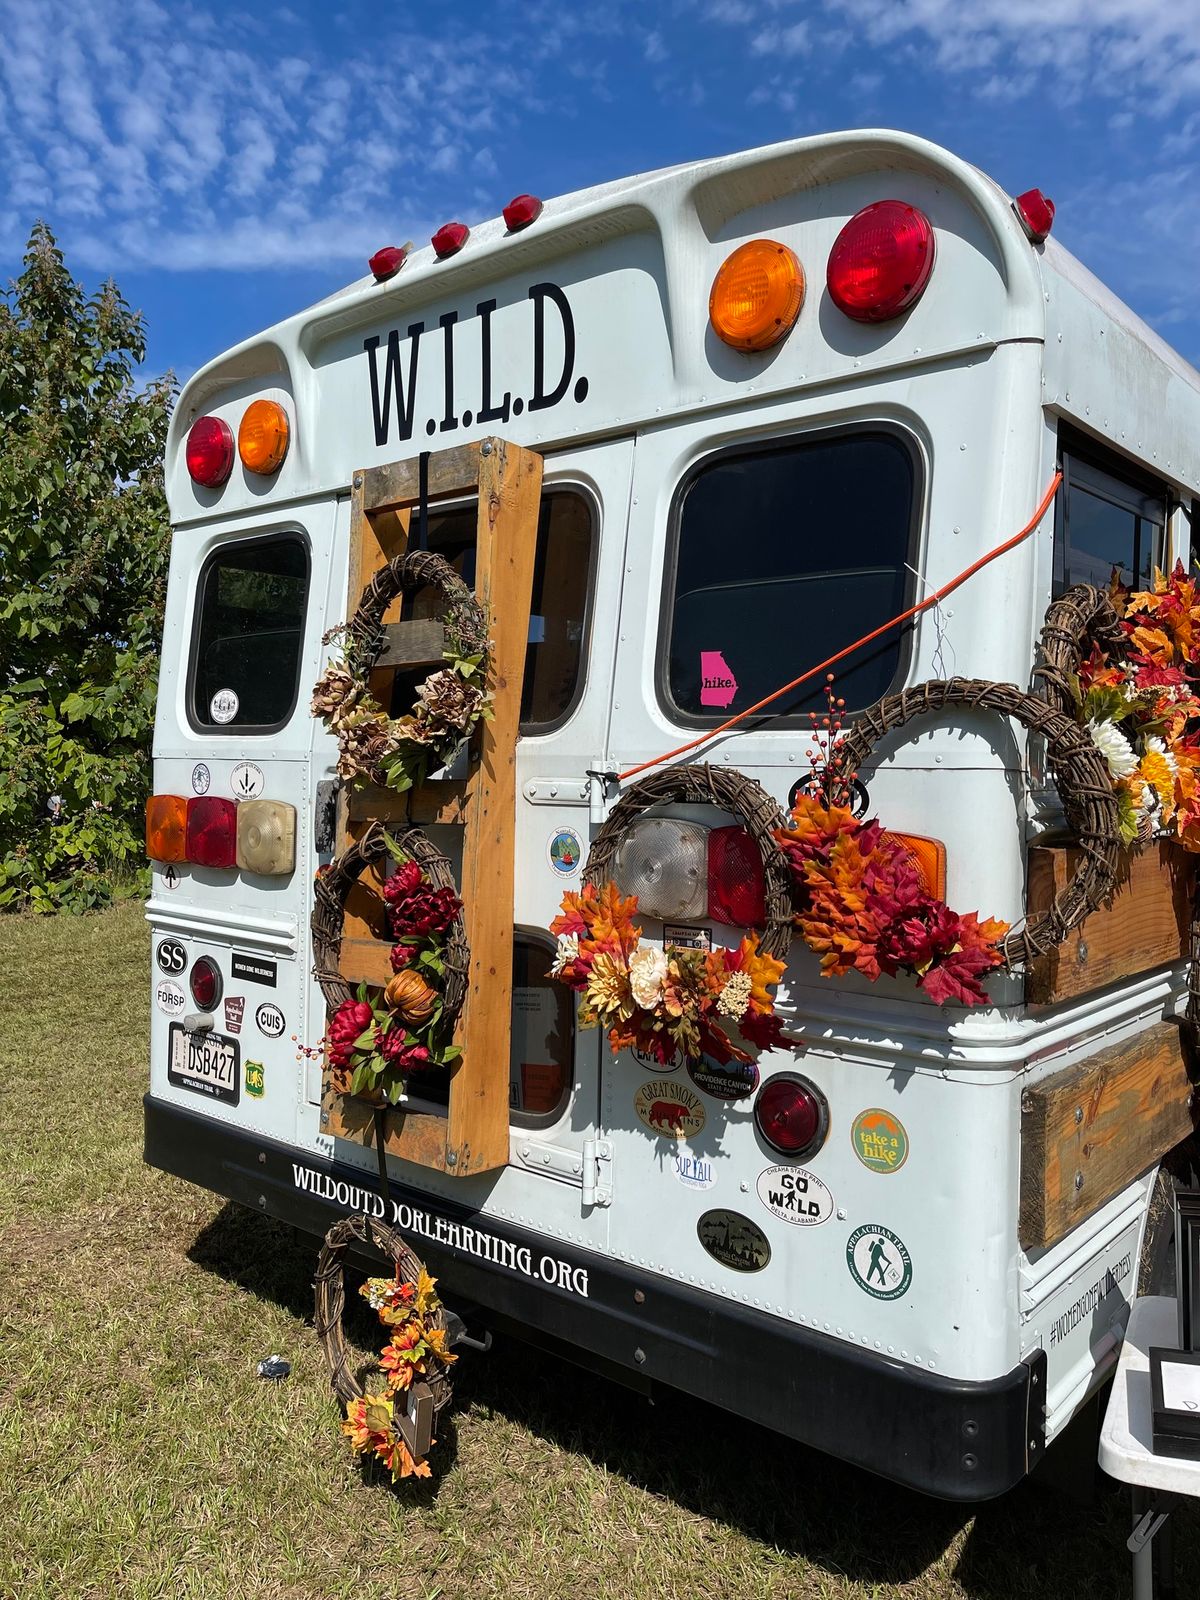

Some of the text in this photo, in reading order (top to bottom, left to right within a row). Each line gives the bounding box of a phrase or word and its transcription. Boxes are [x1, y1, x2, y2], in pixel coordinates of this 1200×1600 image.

[364, 282, 589, 447] W.I.L.D.
[704, 676, 735, 689] hike.
[160, 944, 184, 970] SS
[157, 990, 185, 1007] FDRSP
[260, 1011, 281, 1030] CUIS
[188, 1043, 235, 1083] DSB427
[694, 1072, 751, 1092] PROVIDENCE CANYON
[707, 1083, 737, 1095] STATE PARK
[641, 1082, 701, 1110] GREAT SMOKY
[640, 1108, 700, 1128] MOUNTINS
[860, 1131, 899, 1148] take a
[675, 1154, 692, 1176] SUP
[863, 1142, 897, 1166] hike
[781, 1173, 809, 1194] GO
[790, 1167, 807, 1178] STATE
[808, 1175, 824, 1189] PARK
[768, 1189, 821, 1218] WLD
[292, 1163, 589, 1298] WILDOUTDORLEARNING.ORG
[790, 1216, 818, 1224] ALABAMA
[847, 1225, 911, 1266] APPALACHIAN TRAIL
